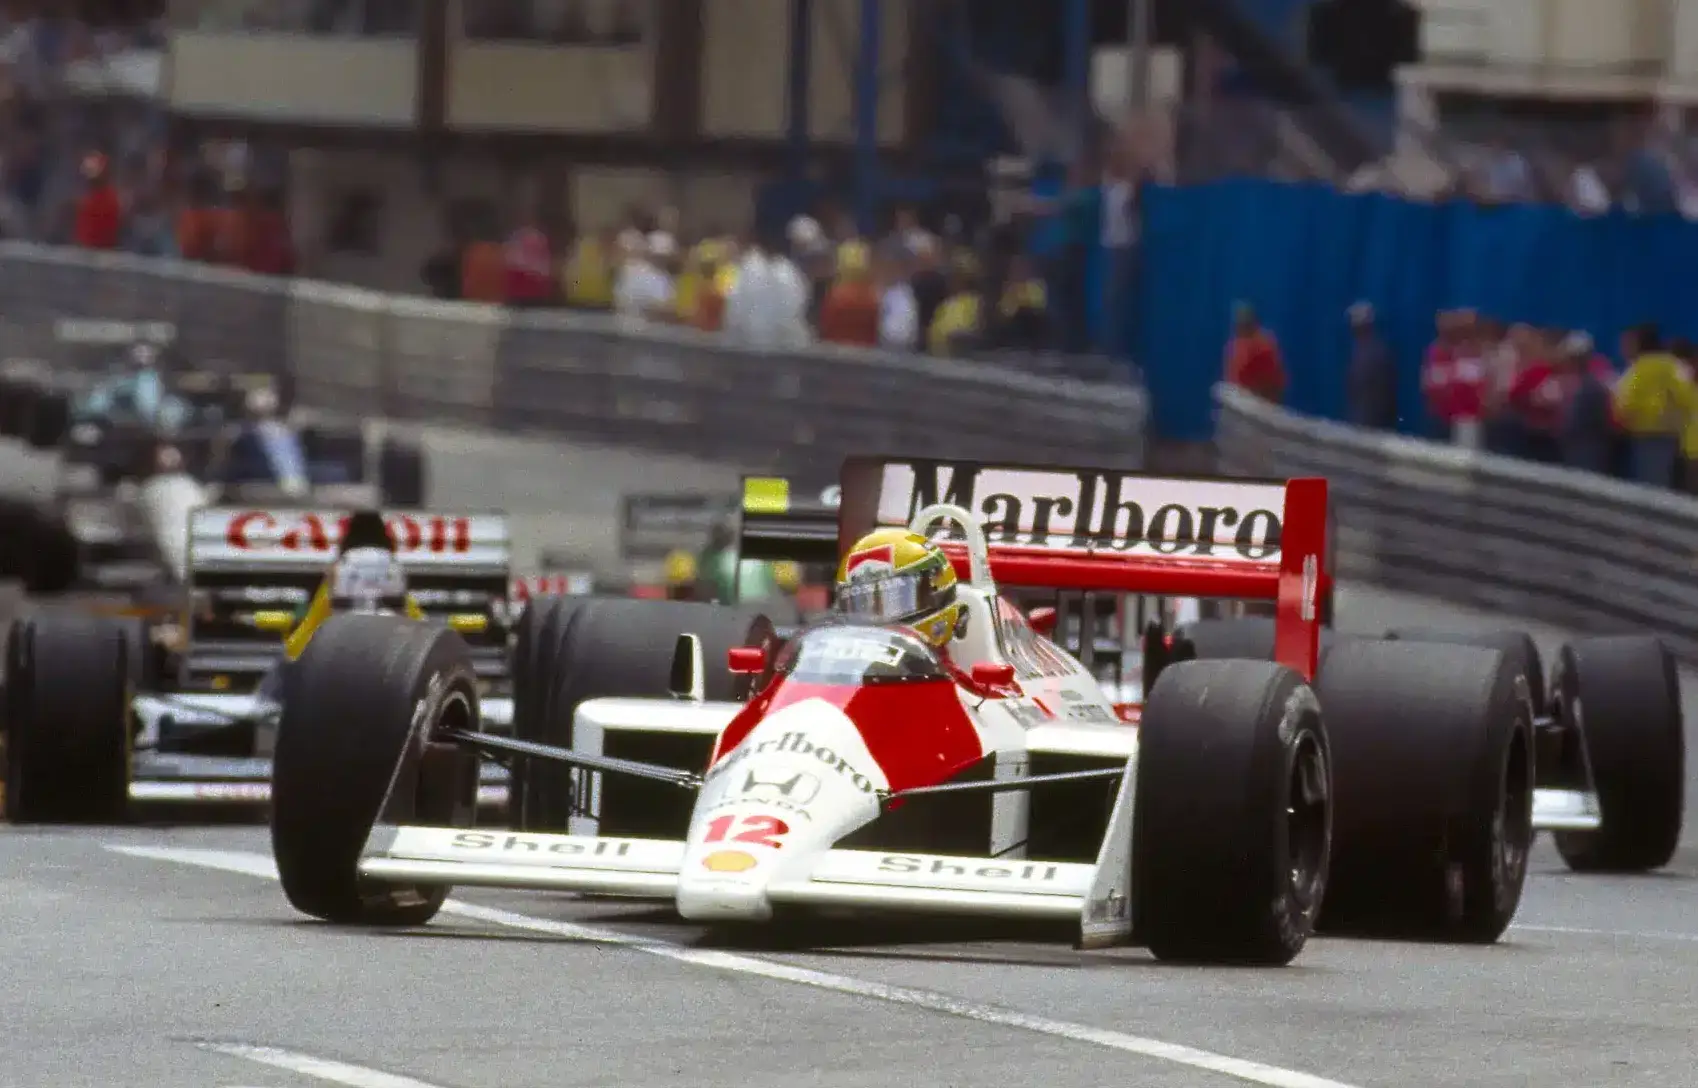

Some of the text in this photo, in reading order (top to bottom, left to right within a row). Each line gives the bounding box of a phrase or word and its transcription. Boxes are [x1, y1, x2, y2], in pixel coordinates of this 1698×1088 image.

[909, 463, 1283, 558] Marlboro
[451, 833, 631, 857] Shell
[703, 815, 789, 849] 12
[877, 856, 1058, 881] Shell
